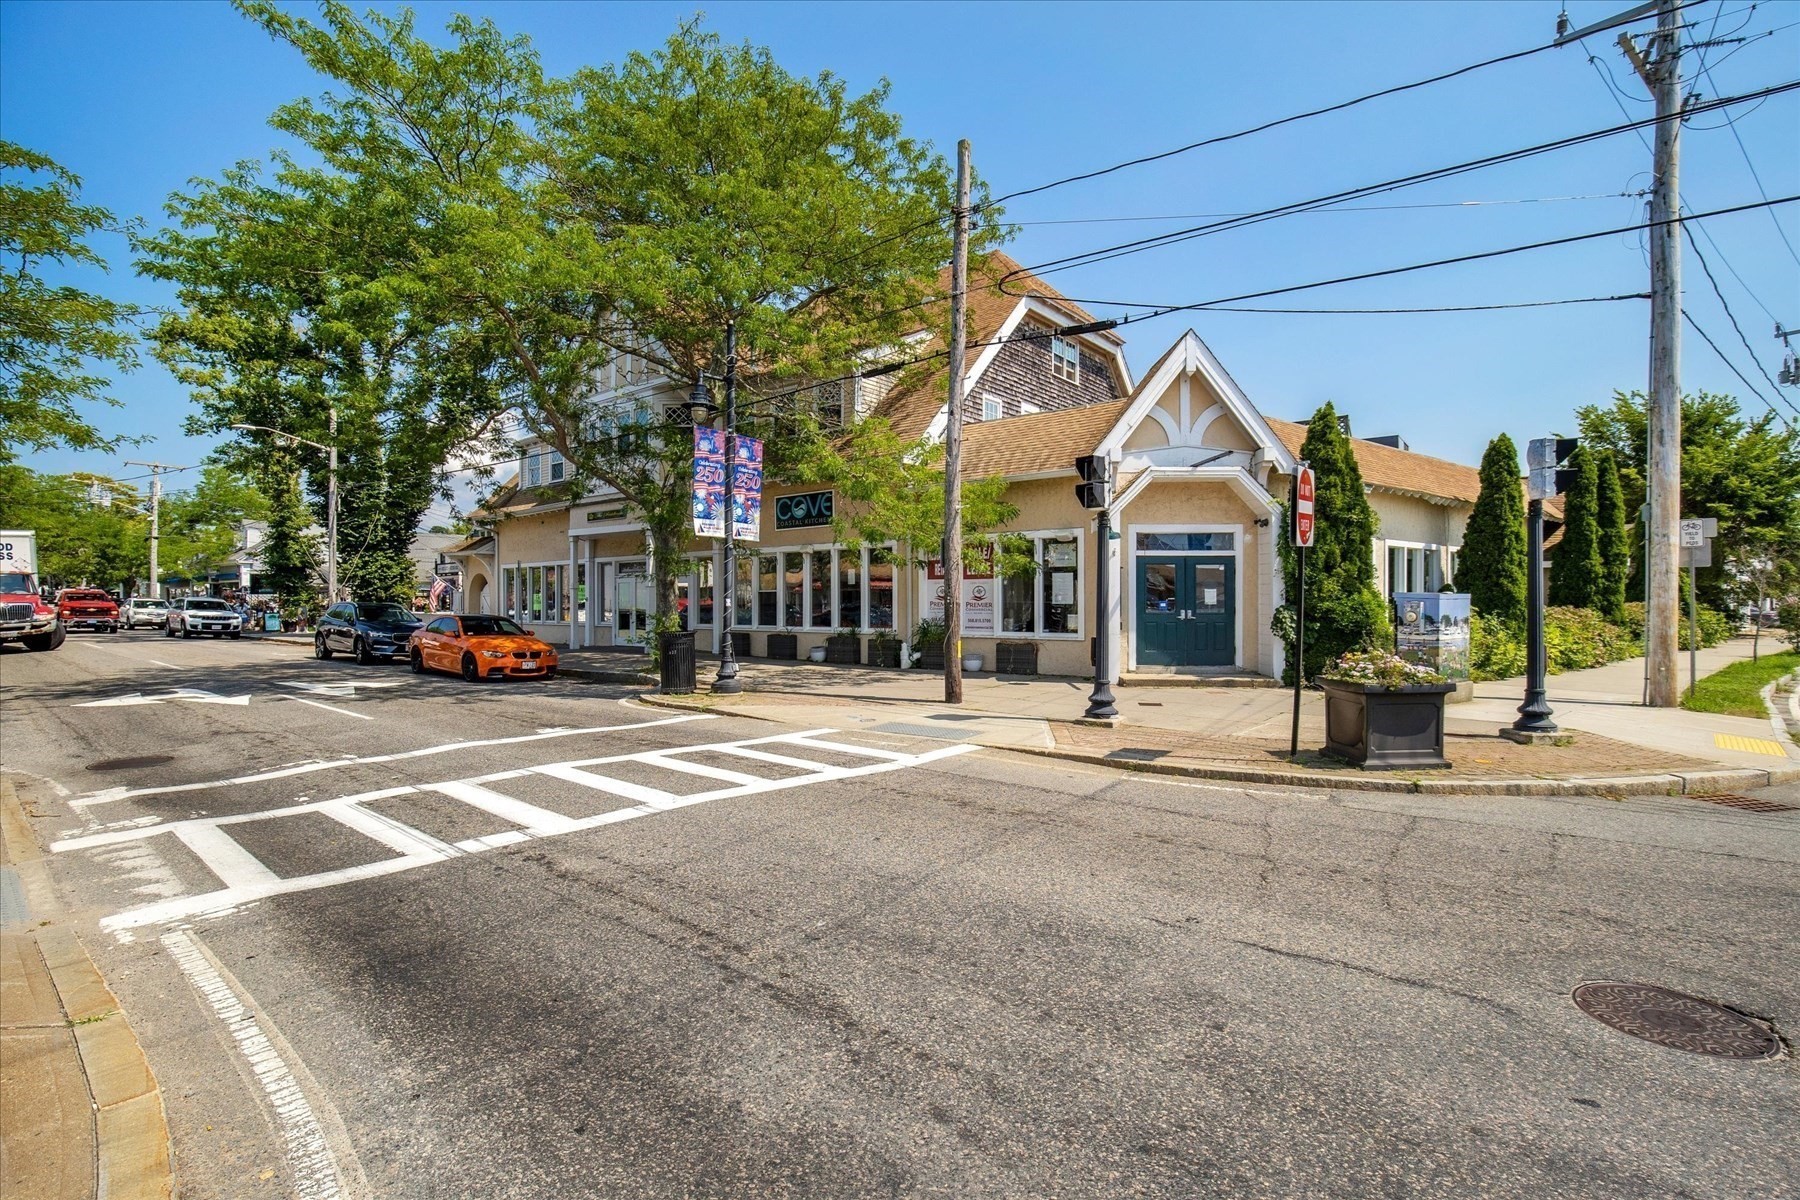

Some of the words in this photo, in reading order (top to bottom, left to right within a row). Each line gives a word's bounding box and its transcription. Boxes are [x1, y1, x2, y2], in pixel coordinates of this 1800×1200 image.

[695, 466, 725, 483] 250
[735, 472, 761, 490] 250
[1300, 482, 1304, 495] DO
[777, 493, 832, 520] COVE
[1300, 519, 1310, 531] ENTER
